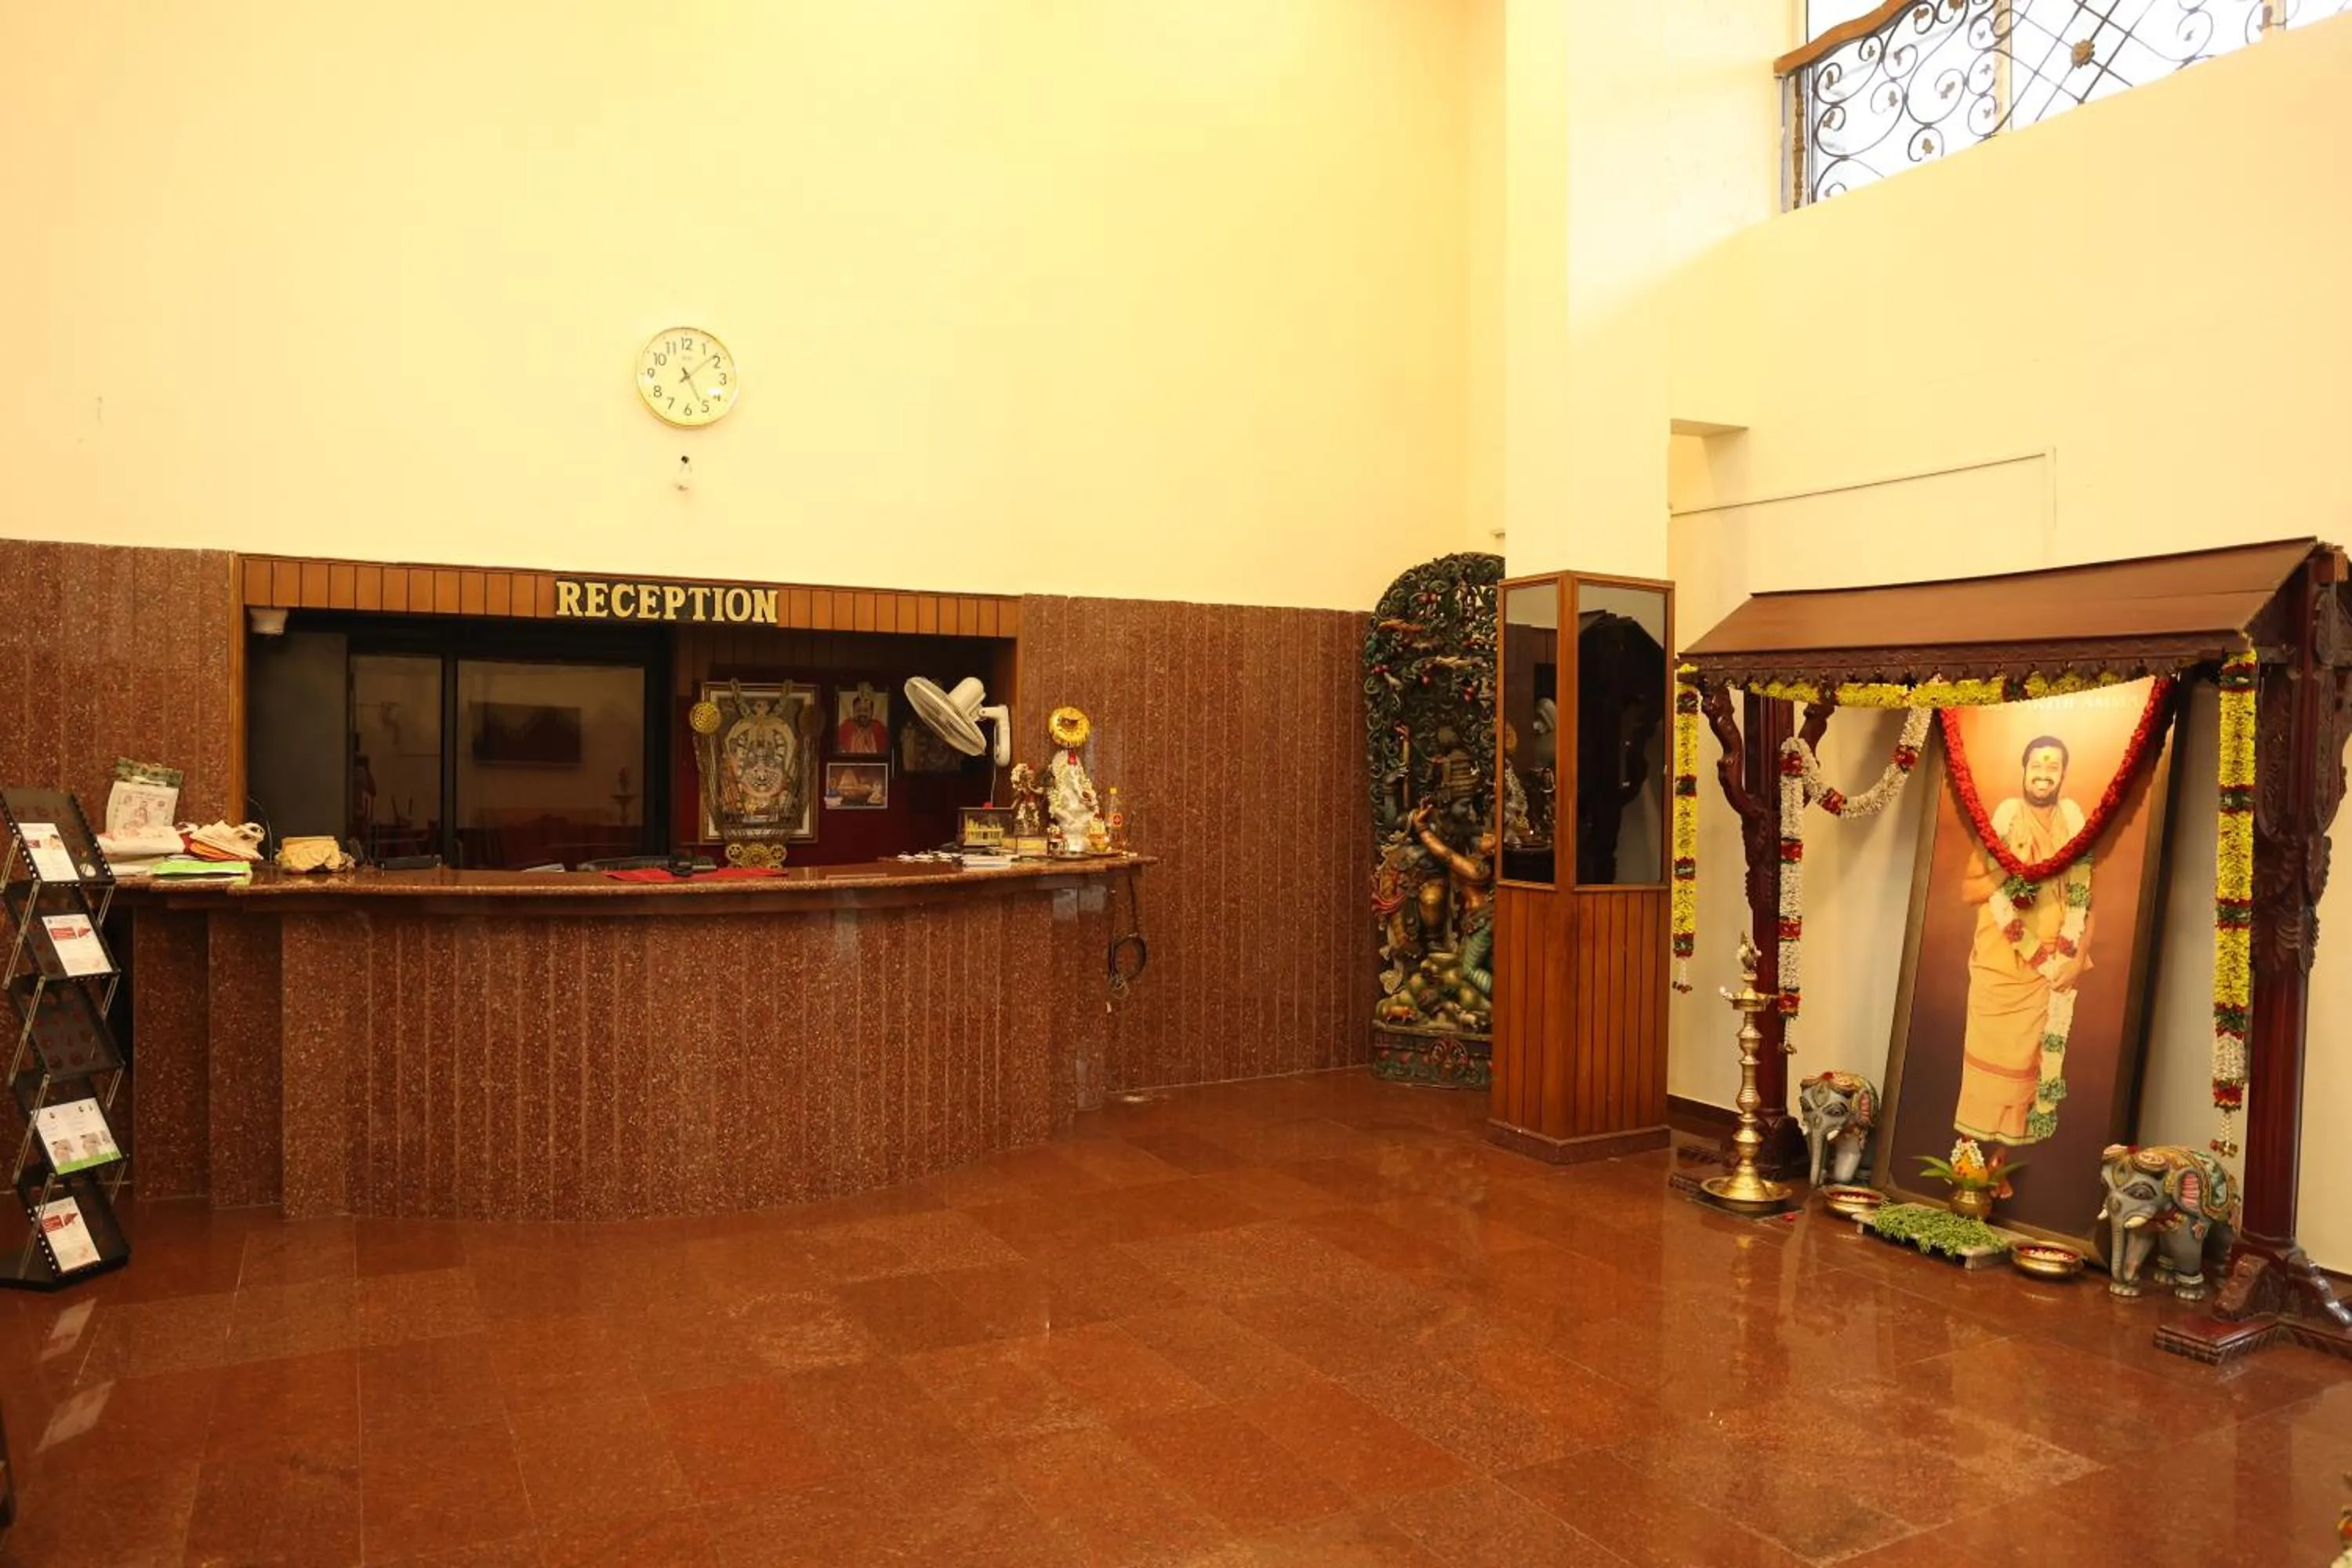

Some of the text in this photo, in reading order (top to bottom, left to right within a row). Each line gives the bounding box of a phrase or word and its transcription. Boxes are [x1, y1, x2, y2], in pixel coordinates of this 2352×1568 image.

[665, 341, 677, 357] 11
[681, 337, 693, 351] 12
[702, 343, 706, 356] 1
[653, 352, 667, 366] 10
[713, 354, 720, 368] 2
[647, 368, 655, 379] 9
[719, 372, 728, 386] 3
[653, 385, 662, 398] 8
[666, 397, 675, 409] 7
[684, 403, 692, 416] 6
[701, 400, 710, 413] 5
[556, 581, 778, 623] RECEPTION
